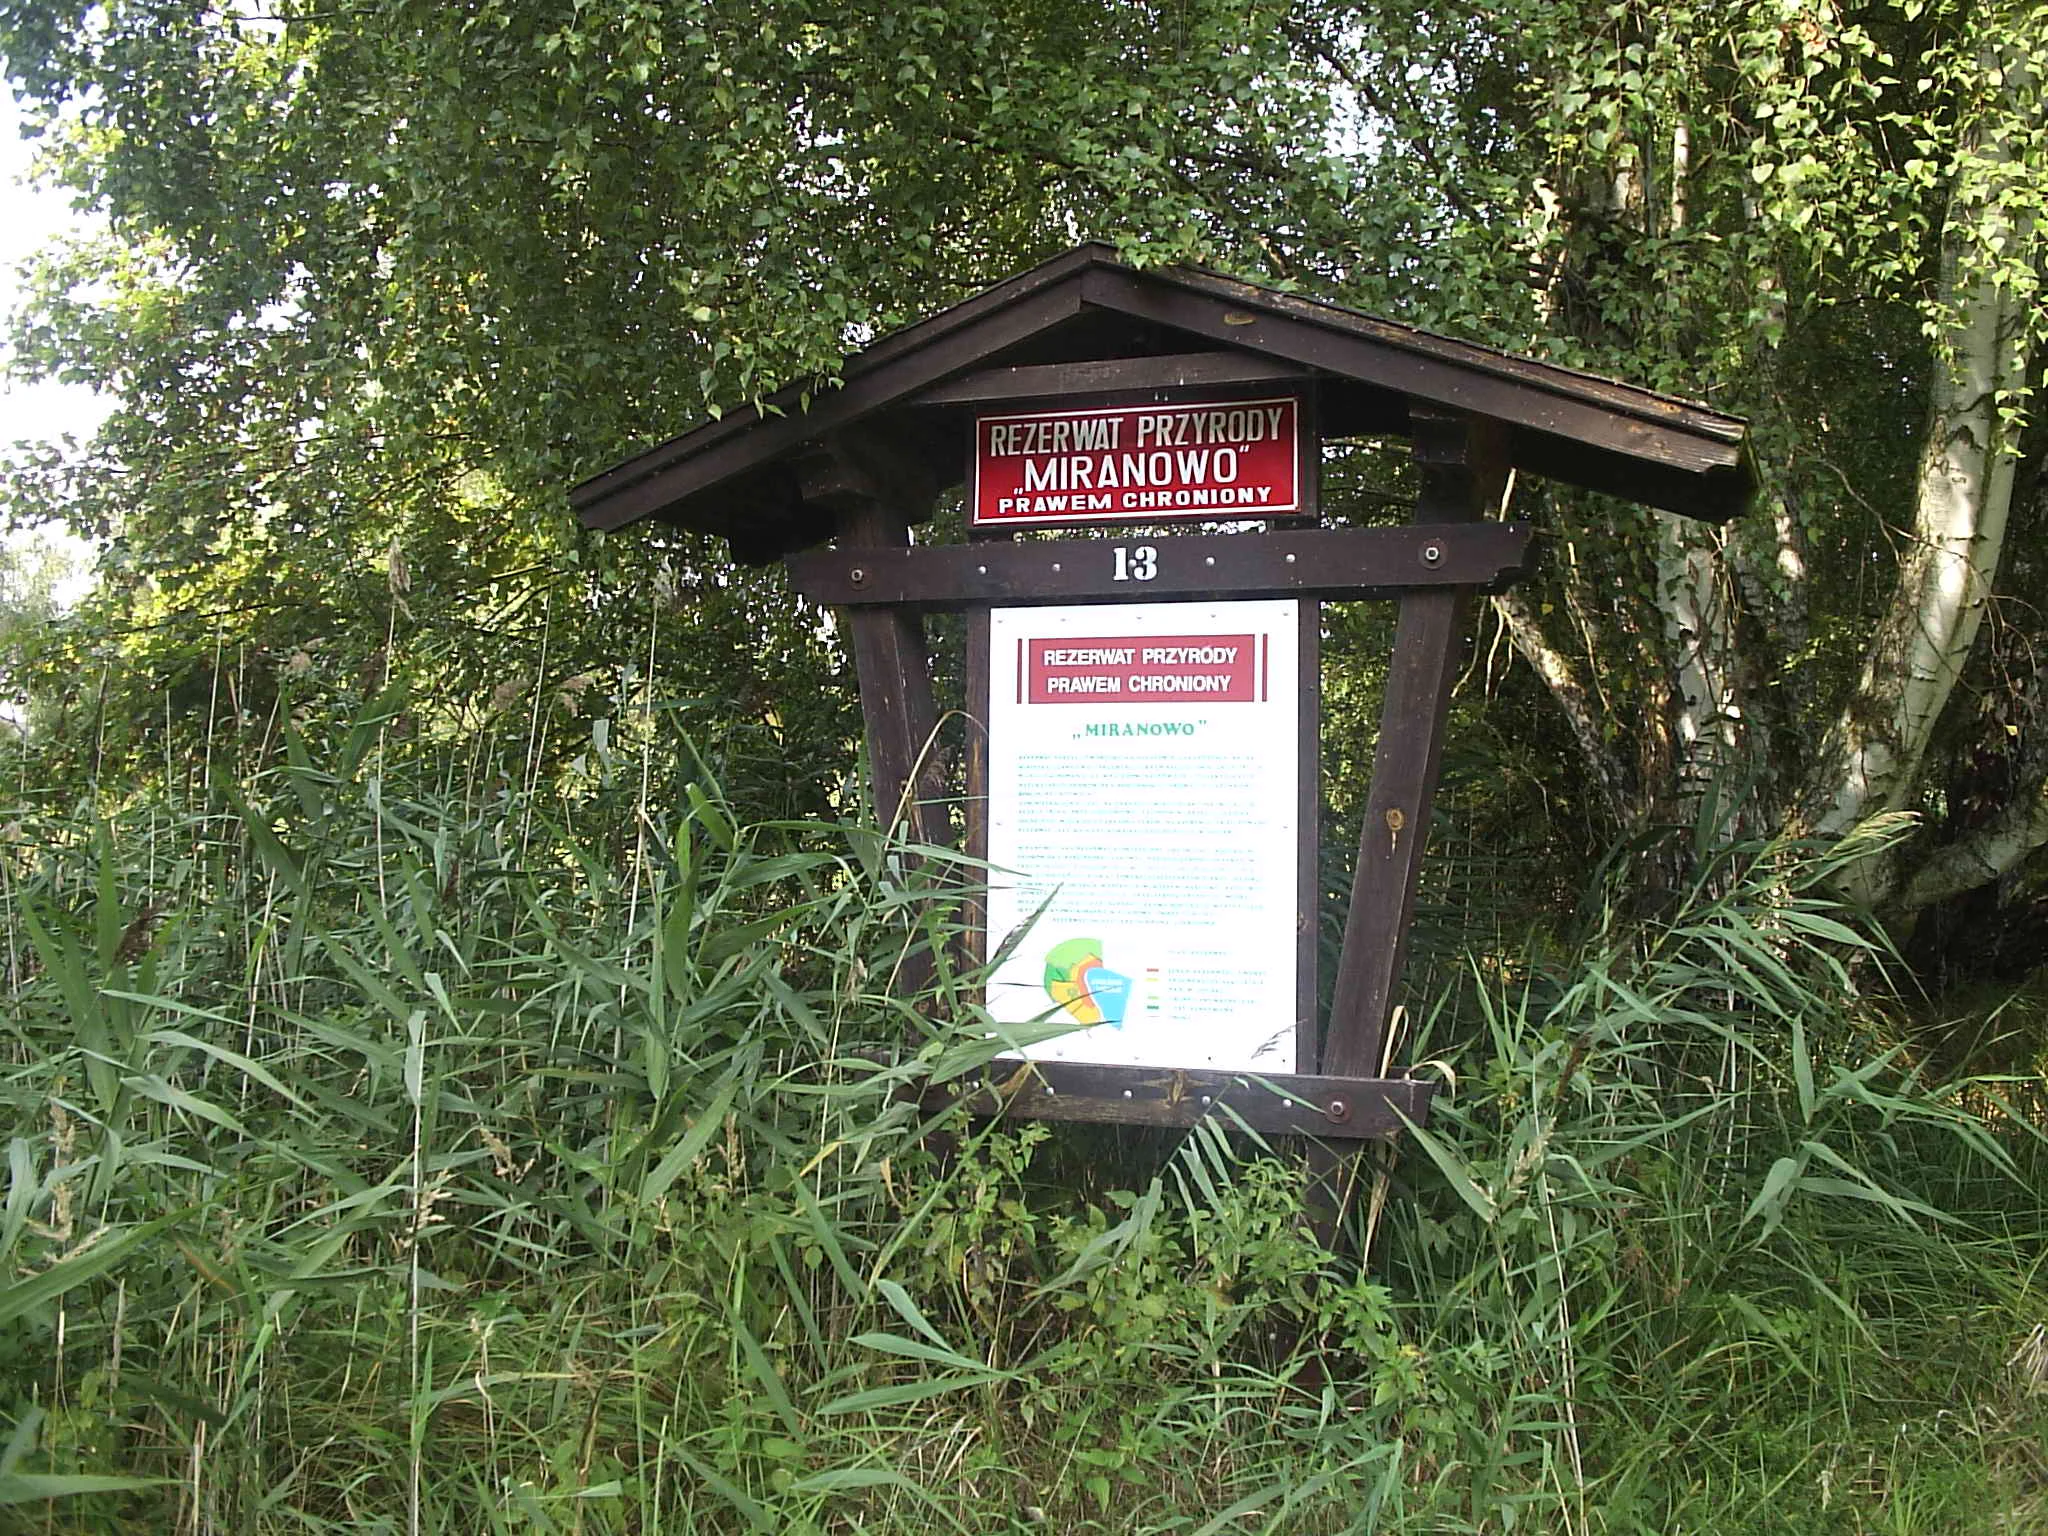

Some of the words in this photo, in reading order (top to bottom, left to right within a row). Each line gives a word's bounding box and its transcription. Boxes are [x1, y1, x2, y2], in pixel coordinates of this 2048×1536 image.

[990, 417, 1123, 457] REZERWAT
[1137, 407, 1283, 449] PRZYRODY
[999, 494, 1112, 514] PRAWEM
[1122, 487, 1272, 508] CHRONIONY
[1113, 546, 1158, 581] 13
[1043, 648, 1136, 666] REZERWAT
[1142, 647, 1238, 665] PRZYRODY
[1047, 676, 1121, 693] PRAWEM
[1128, 674, 1232, 692] CHRONIONY
